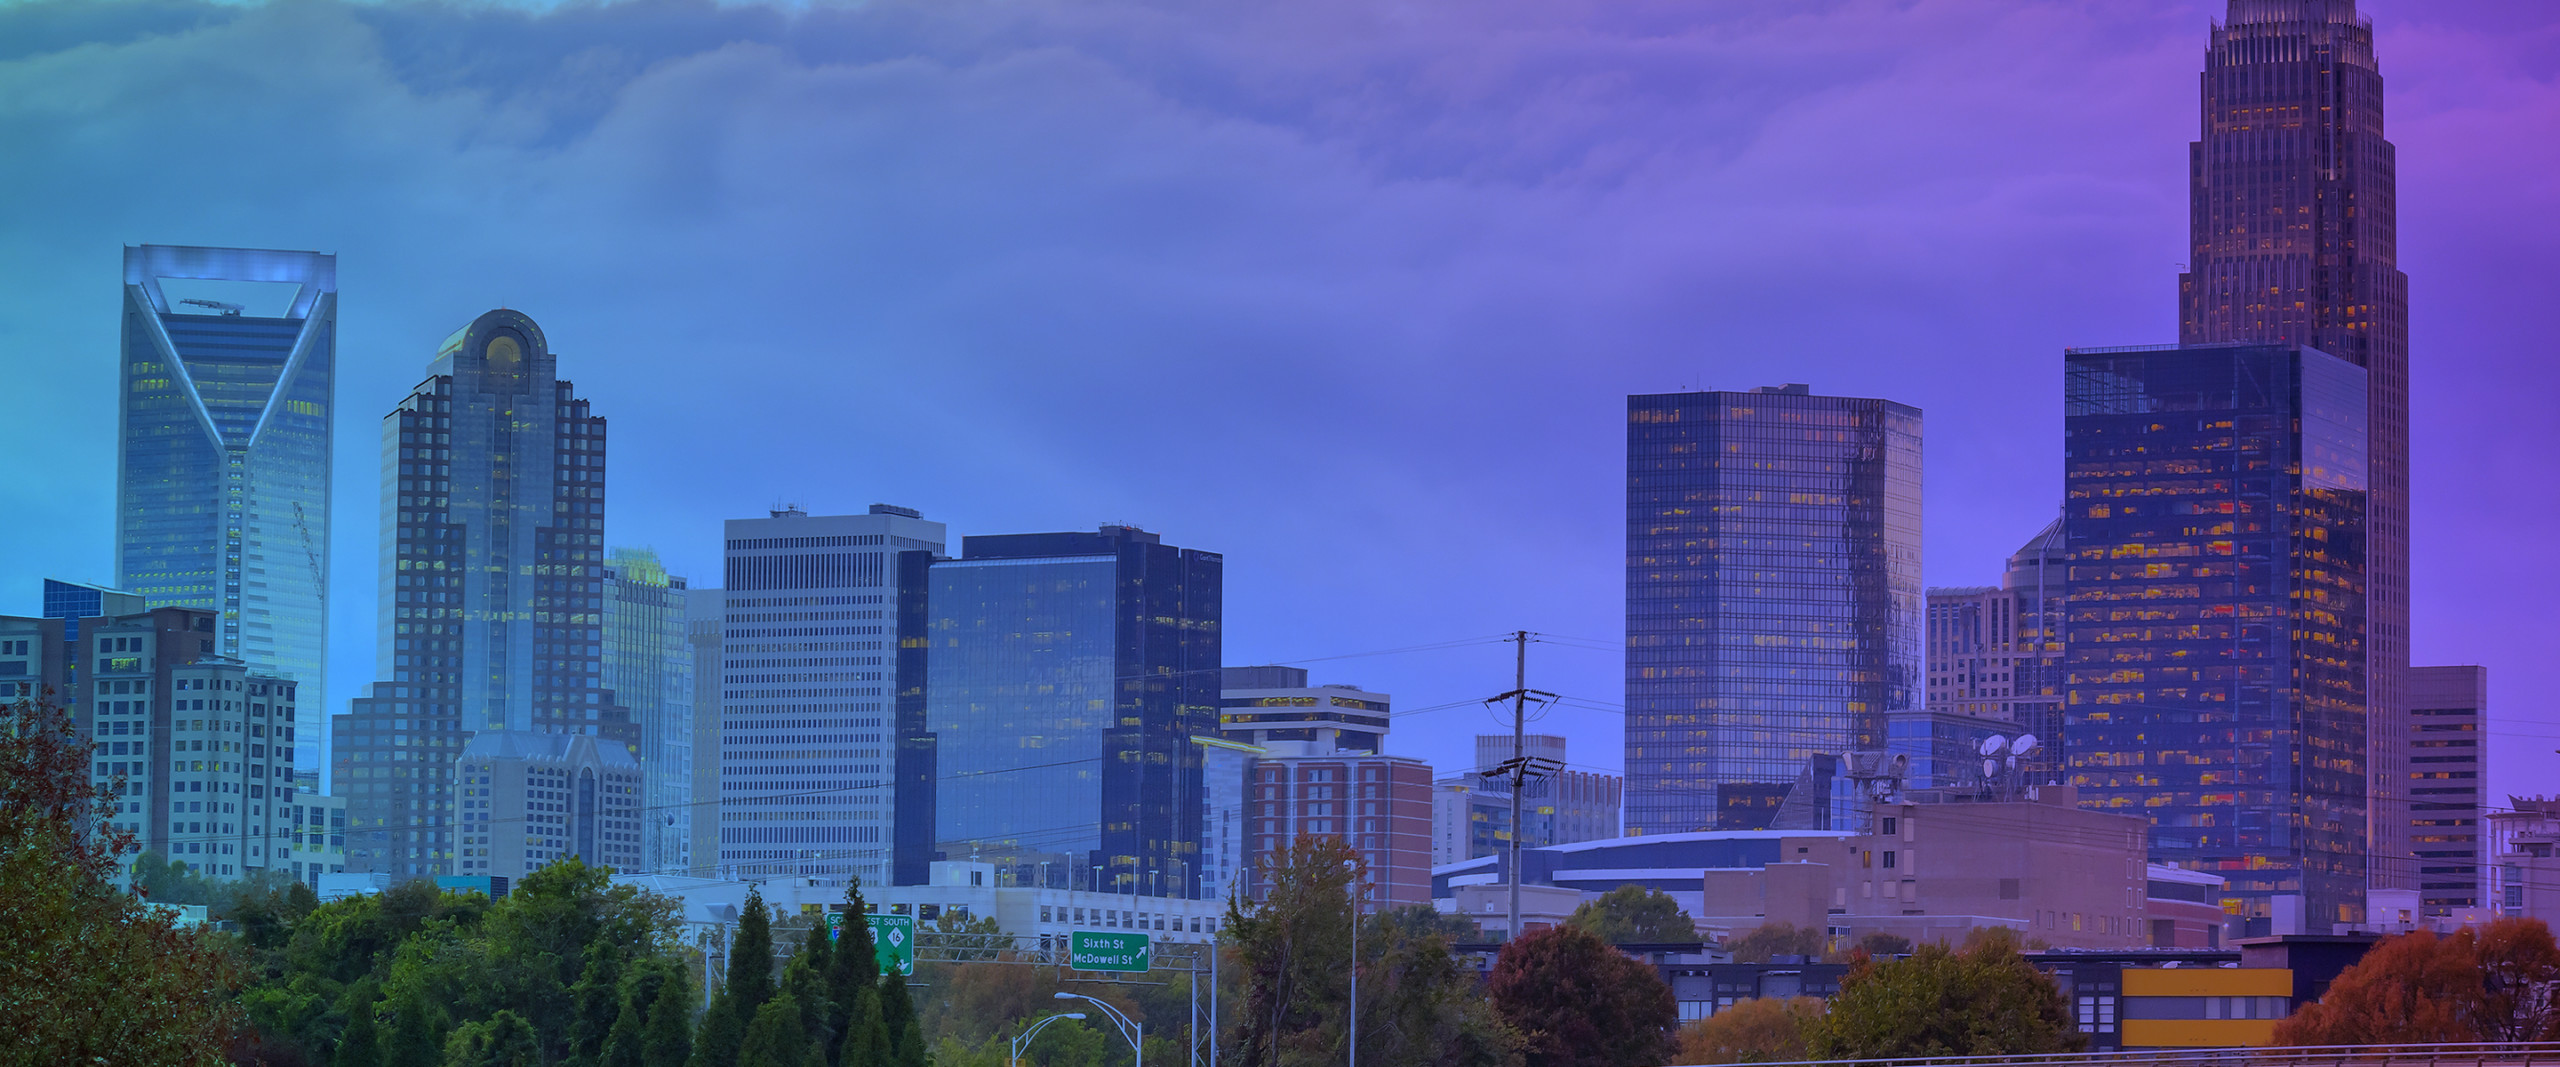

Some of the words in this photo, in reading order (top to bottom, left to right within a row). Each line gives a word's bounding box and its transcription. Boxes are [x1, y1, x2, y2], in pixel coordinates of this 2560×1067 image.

[883, 918, 910, 926] SOUTH
[892, 932, 901, 942] 16
[1083, 938, 1110, 949] Sixth
[1113, 939, 1124, 949] St
[1073, 953, 1119, 964] McDowell
[1121, 954, 1133, 965] St
